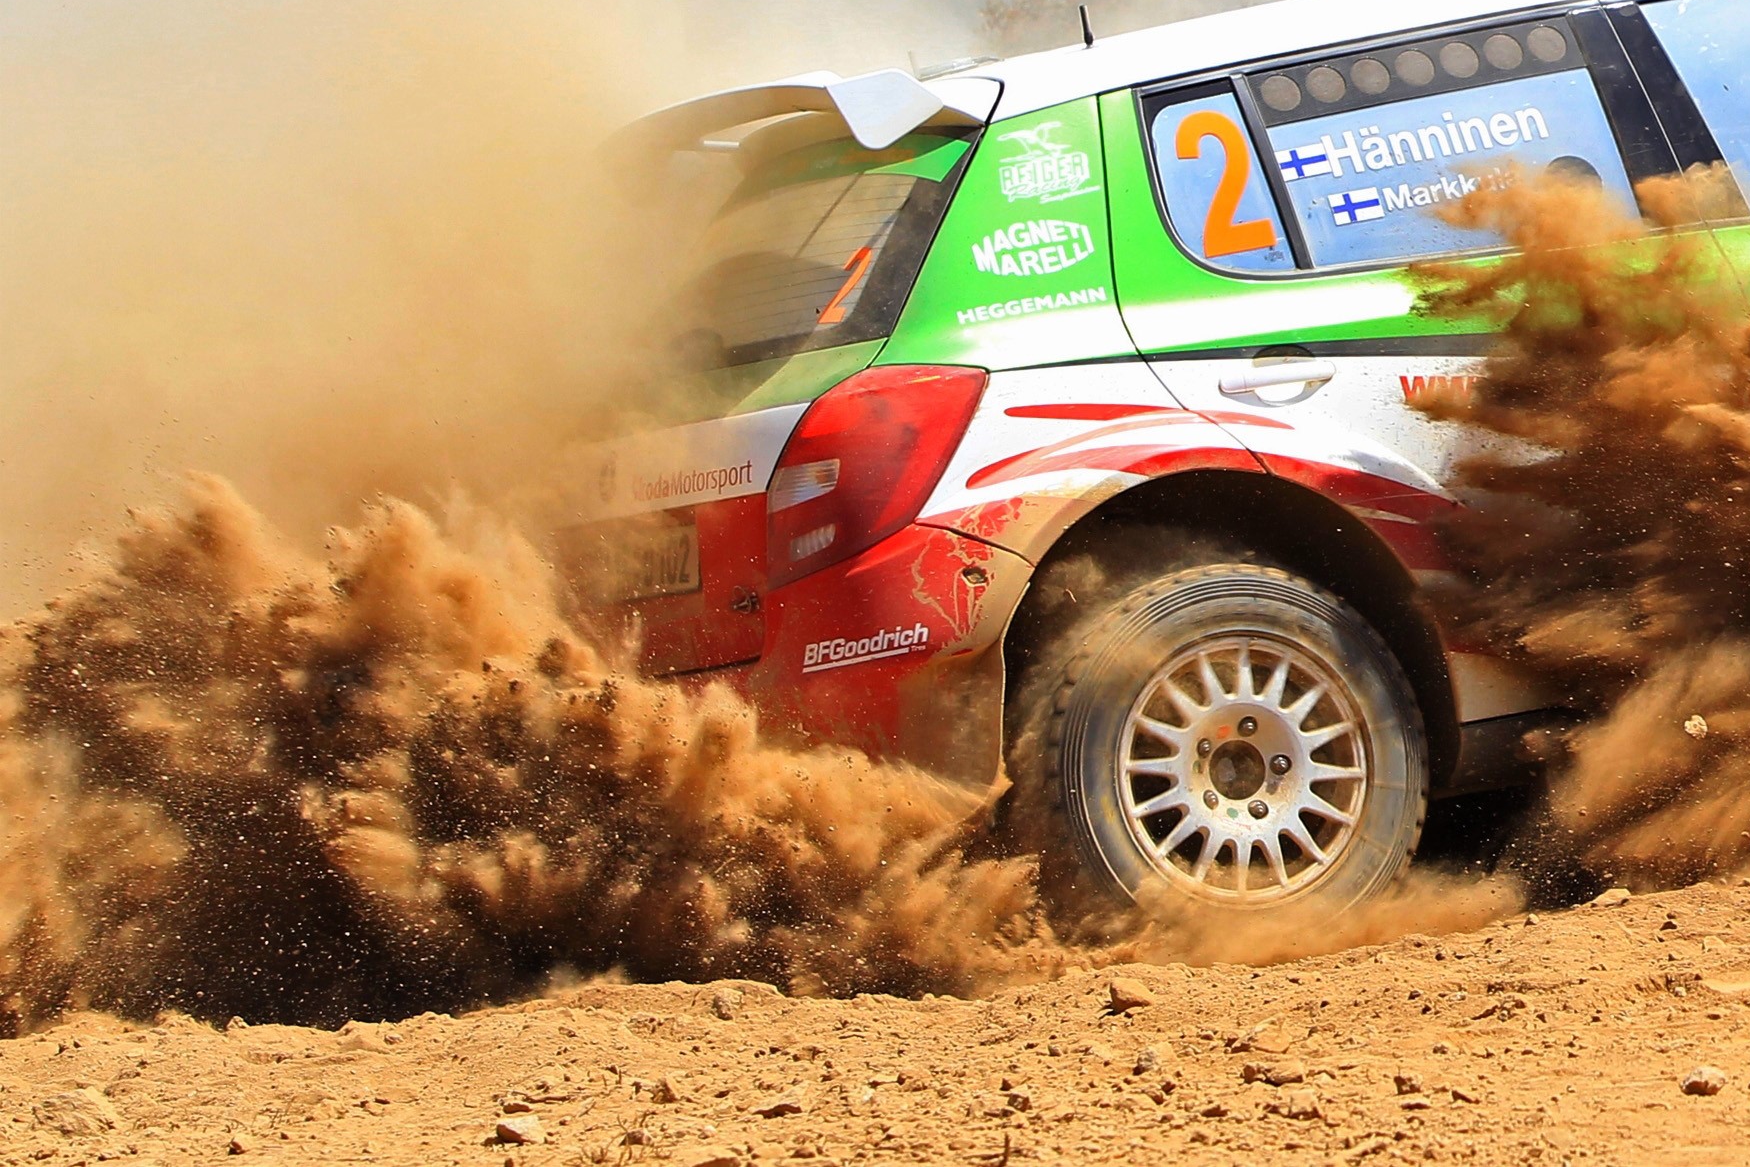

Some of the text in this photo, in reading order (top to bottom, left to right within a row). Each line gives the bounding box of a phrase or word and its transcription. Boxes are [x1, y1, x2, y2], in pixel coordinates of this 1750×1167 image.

[1321, 107, 1549, 177] Hänninen
[1175, 110, 1277, 258] 2
[816, 246, 873, 324] 2
[956, 286, 1108, 325] HEGGEMANN
[803, 622, 929, 666] BFGoodrich
